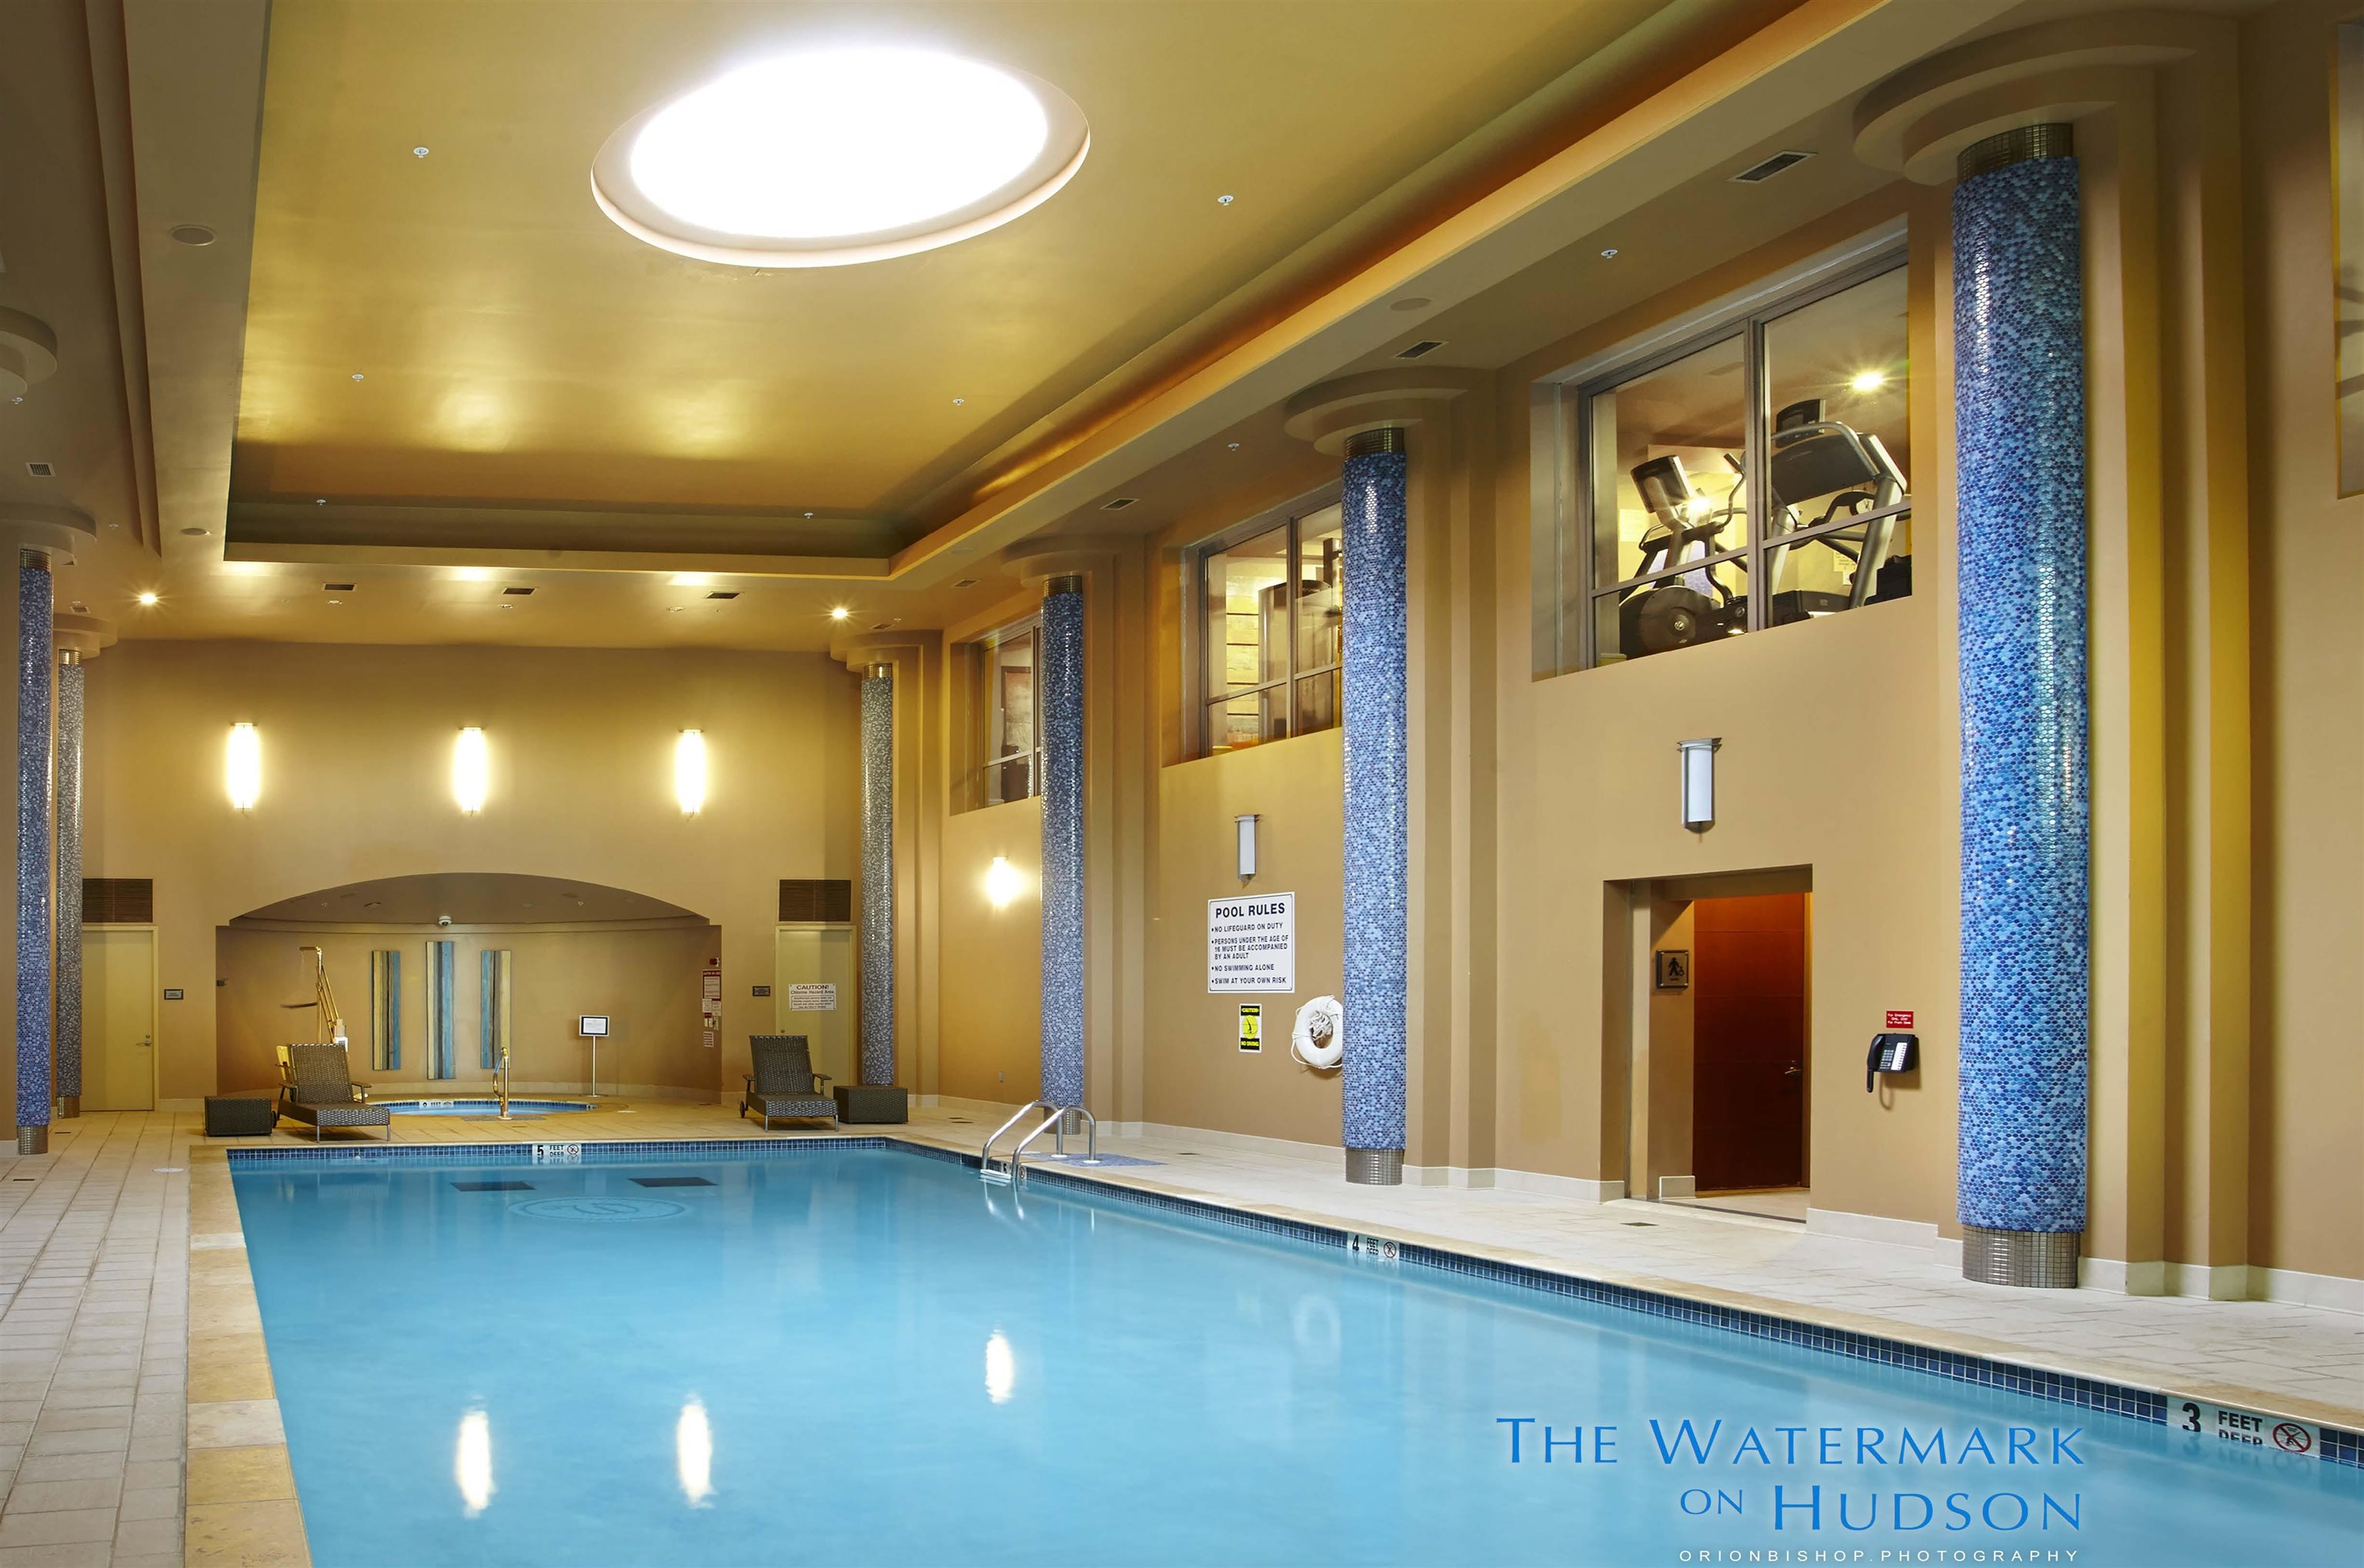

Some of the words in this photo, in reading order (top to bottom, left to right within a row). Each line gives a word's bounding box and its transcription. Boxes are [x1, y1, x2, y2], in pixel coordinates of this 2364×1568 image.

[1216, 906, 1244, 919] POOL
[1248, 902, 1285, 916] RULES
[1247, 942, 1288, 951] ACCOMPANIED
[537, 1145, 544, 1157] 5
[1353, 1235, 1359, 1251] 4
[1367, 1237, 1379, 1248] FEET
[2182, 1402, 2202, 1433] 3
[2218, 1410, 2263, 1433] FEET
